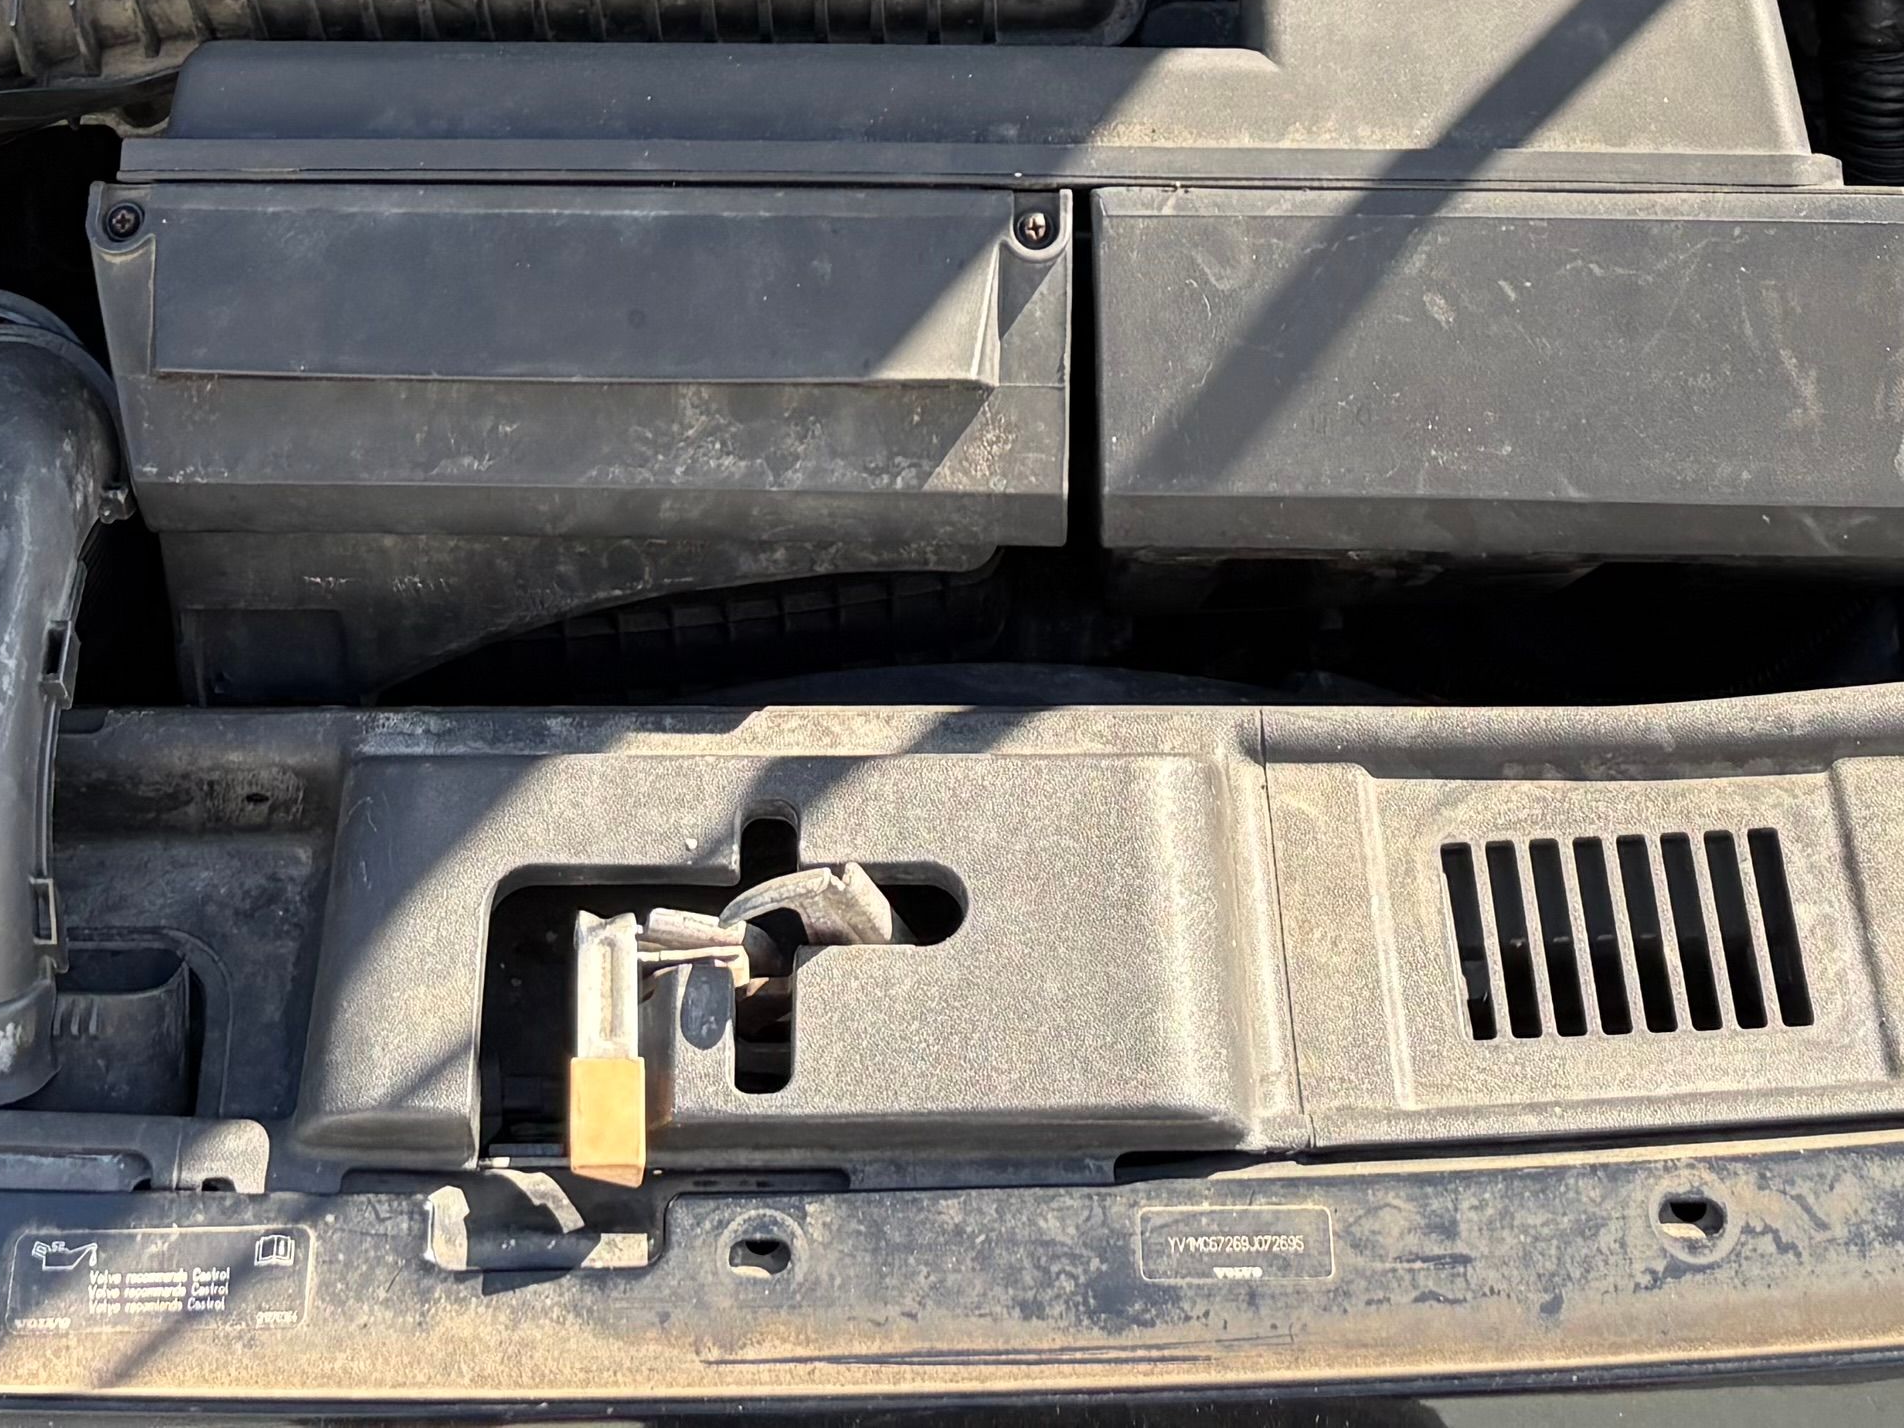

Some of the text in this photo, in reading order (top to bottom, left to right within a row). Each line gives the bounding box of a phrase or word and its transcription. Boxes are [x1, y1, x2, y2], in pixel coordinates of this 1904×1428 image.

[192, 1266, 231, 1283] Castrol
[191, 1281, 229, 1297] Castrol
[187, 1297, 226, 1312] Castrol
